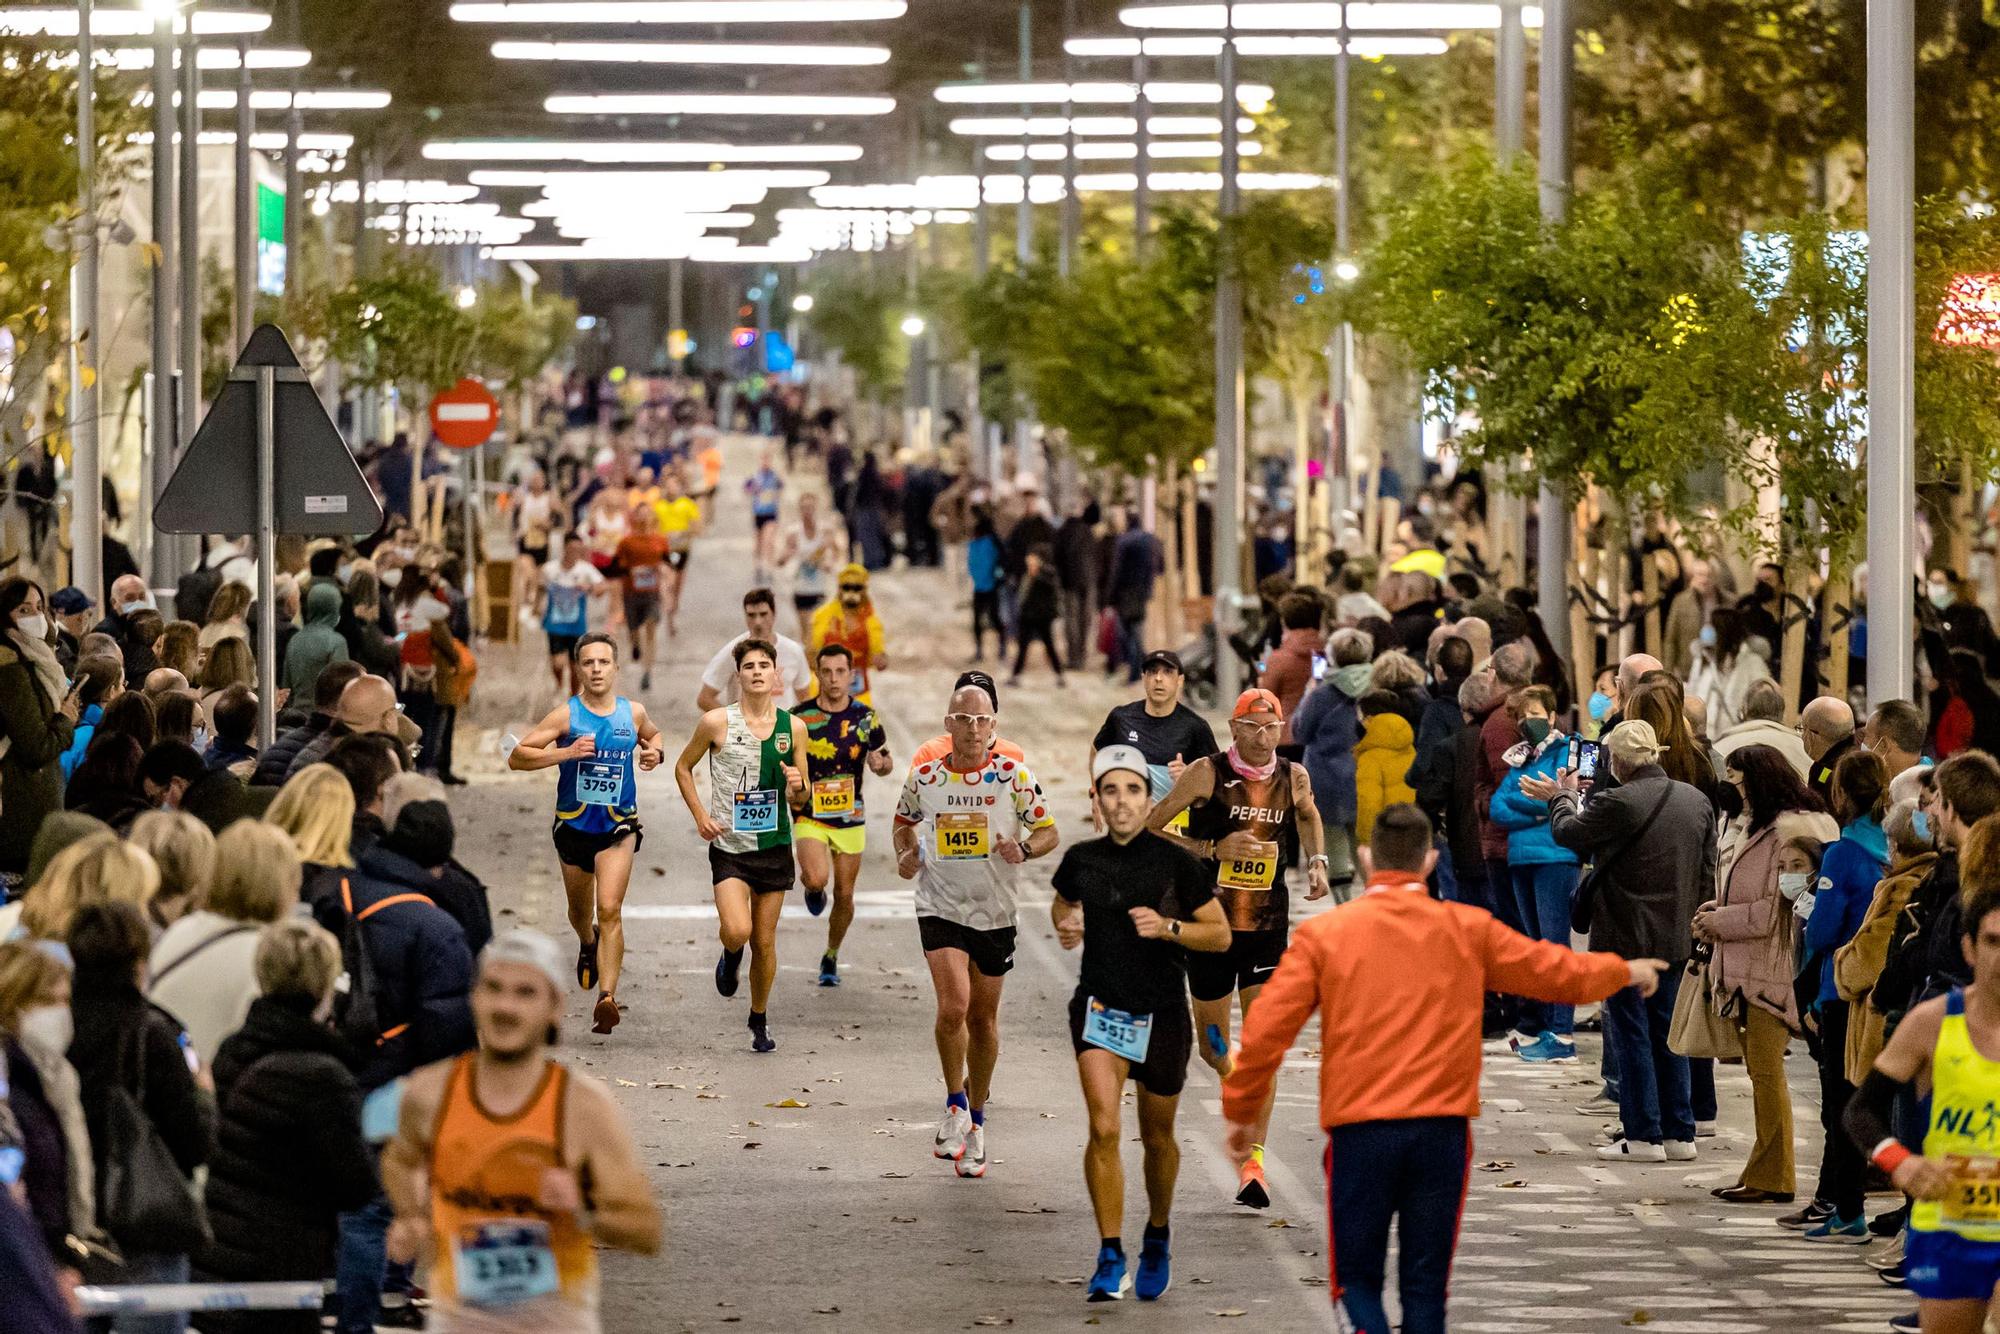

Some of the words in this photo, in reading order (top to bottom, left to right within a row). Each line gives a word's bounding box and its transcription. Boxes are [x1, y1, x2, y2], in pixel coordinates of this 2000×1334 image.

[583, 778, 617, 793] 3759
[820, 795, 848, 806] 1653
[947, 795, 983, 807] DAVID
[740, 807, 772, 820] 2967
[1229, 805, 1284, 824] PEPELU
[945, 832, 979, 846] 1415
[1232, 860, 1266, 876] 880
[1097, 1019, 1138, 1044] 3513
